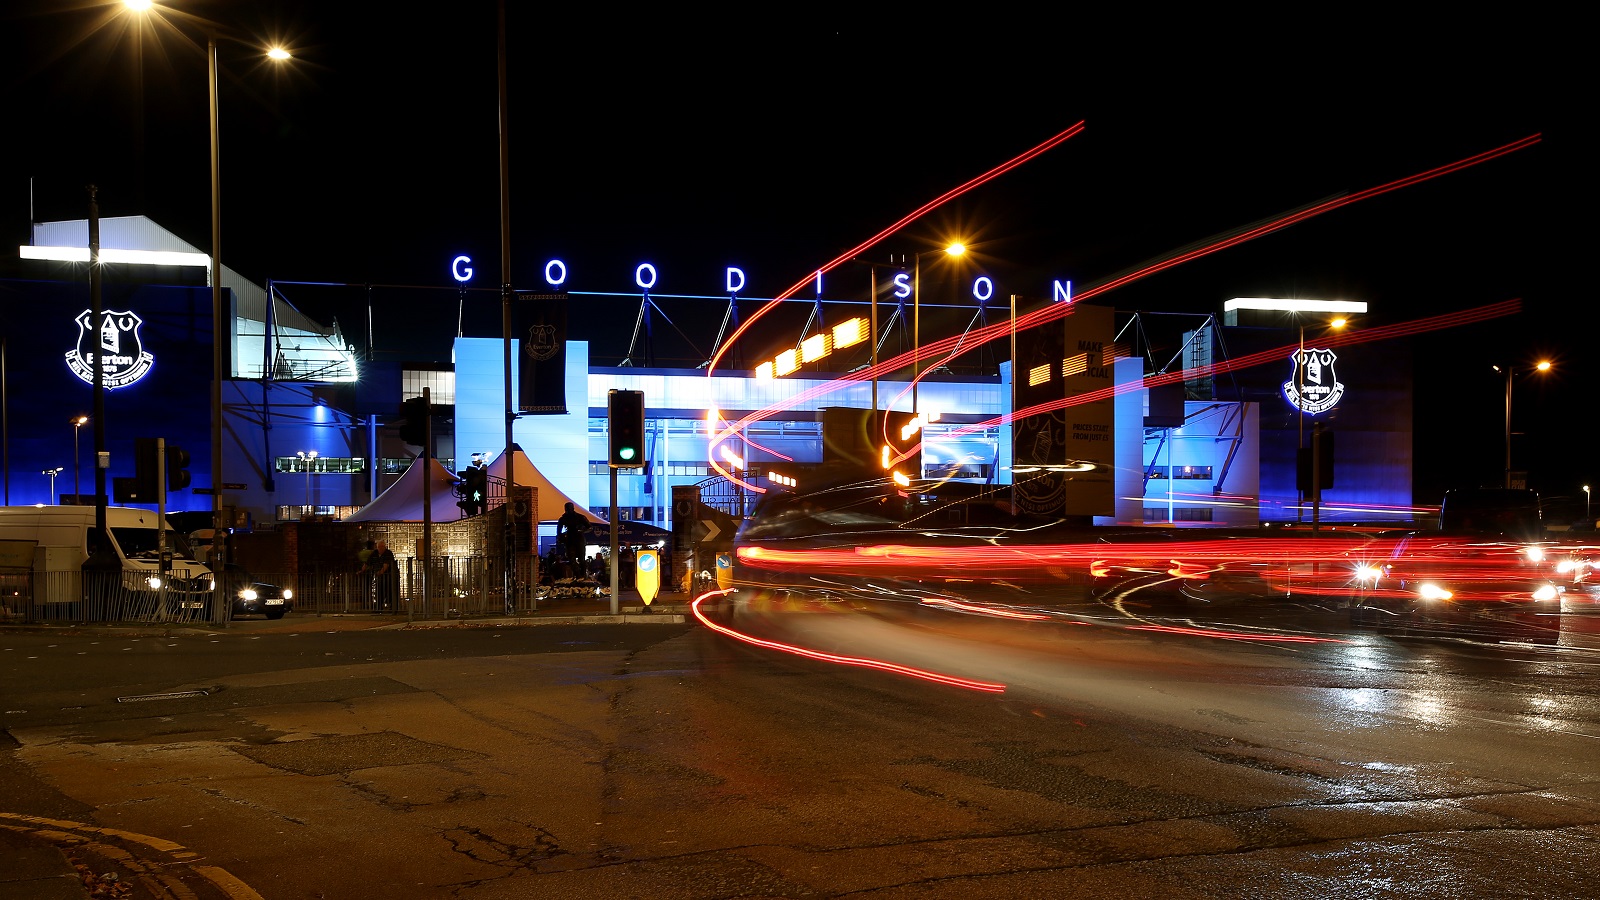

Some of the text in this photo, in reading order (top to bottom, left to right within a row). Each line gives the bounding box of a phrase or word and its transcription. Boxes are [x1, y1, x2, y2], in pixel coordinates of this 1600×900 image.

[1078, 340, 1103, 352] MAKE
[87, 353, 132, 365] Eerton
[1072, 423, 1091, 431] PRICES
[1087, 433, 1102, 442] JUST
